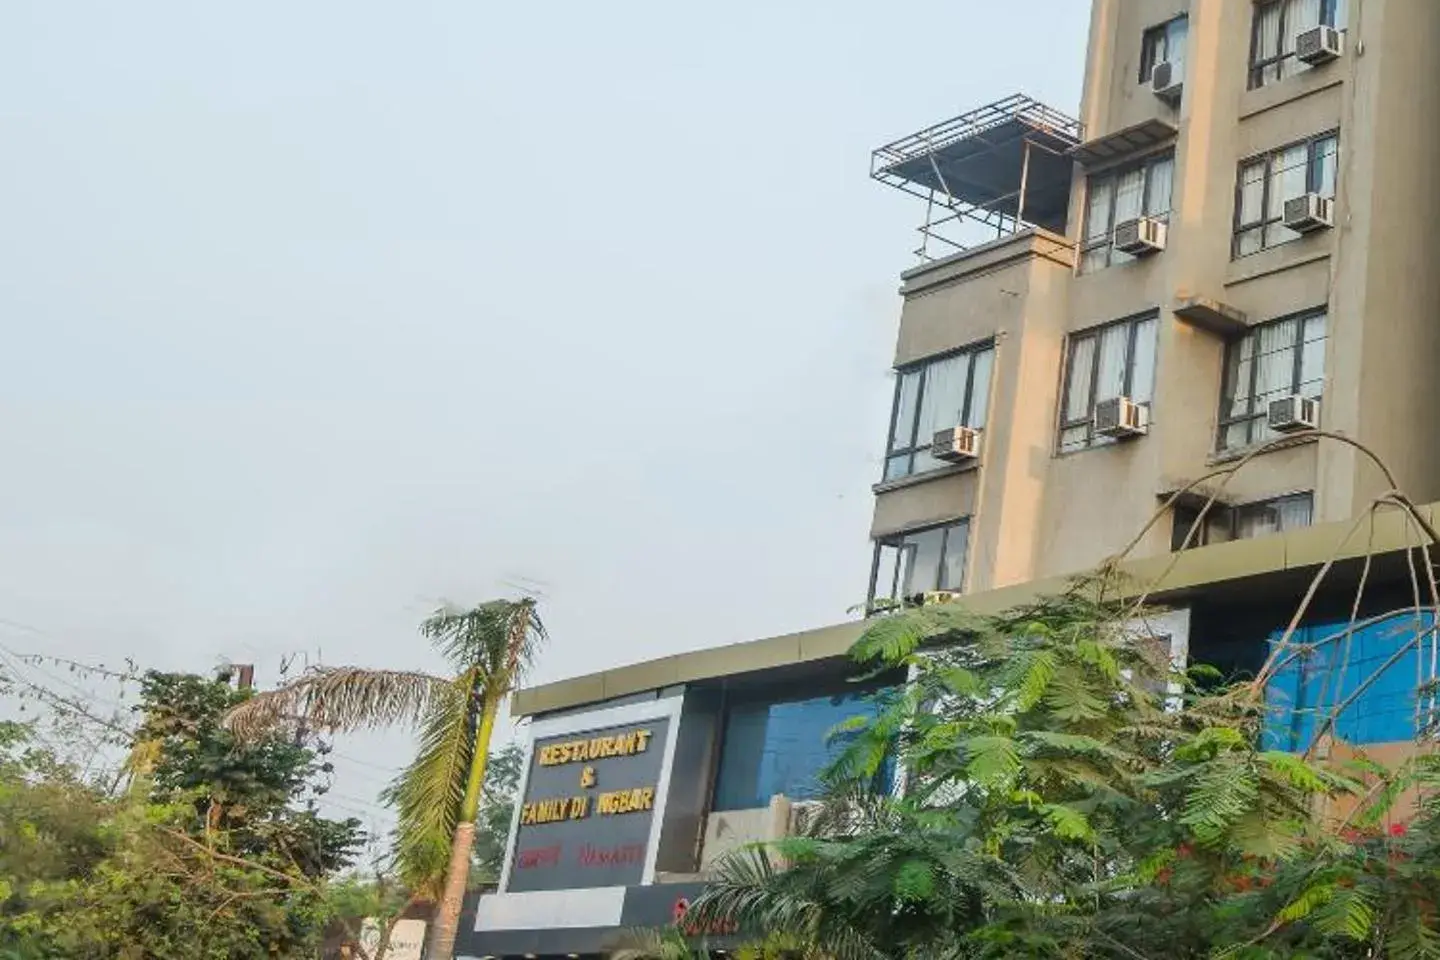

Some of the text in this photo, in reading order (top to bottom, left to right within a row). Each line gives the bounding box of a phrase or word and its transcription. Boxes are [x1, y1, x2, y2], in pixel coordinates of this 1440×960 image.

[538, 728, 652, 767] RESTAURANT
[580, 765, 598, 789] &
[519, 799, 570, 826] FAMILY
